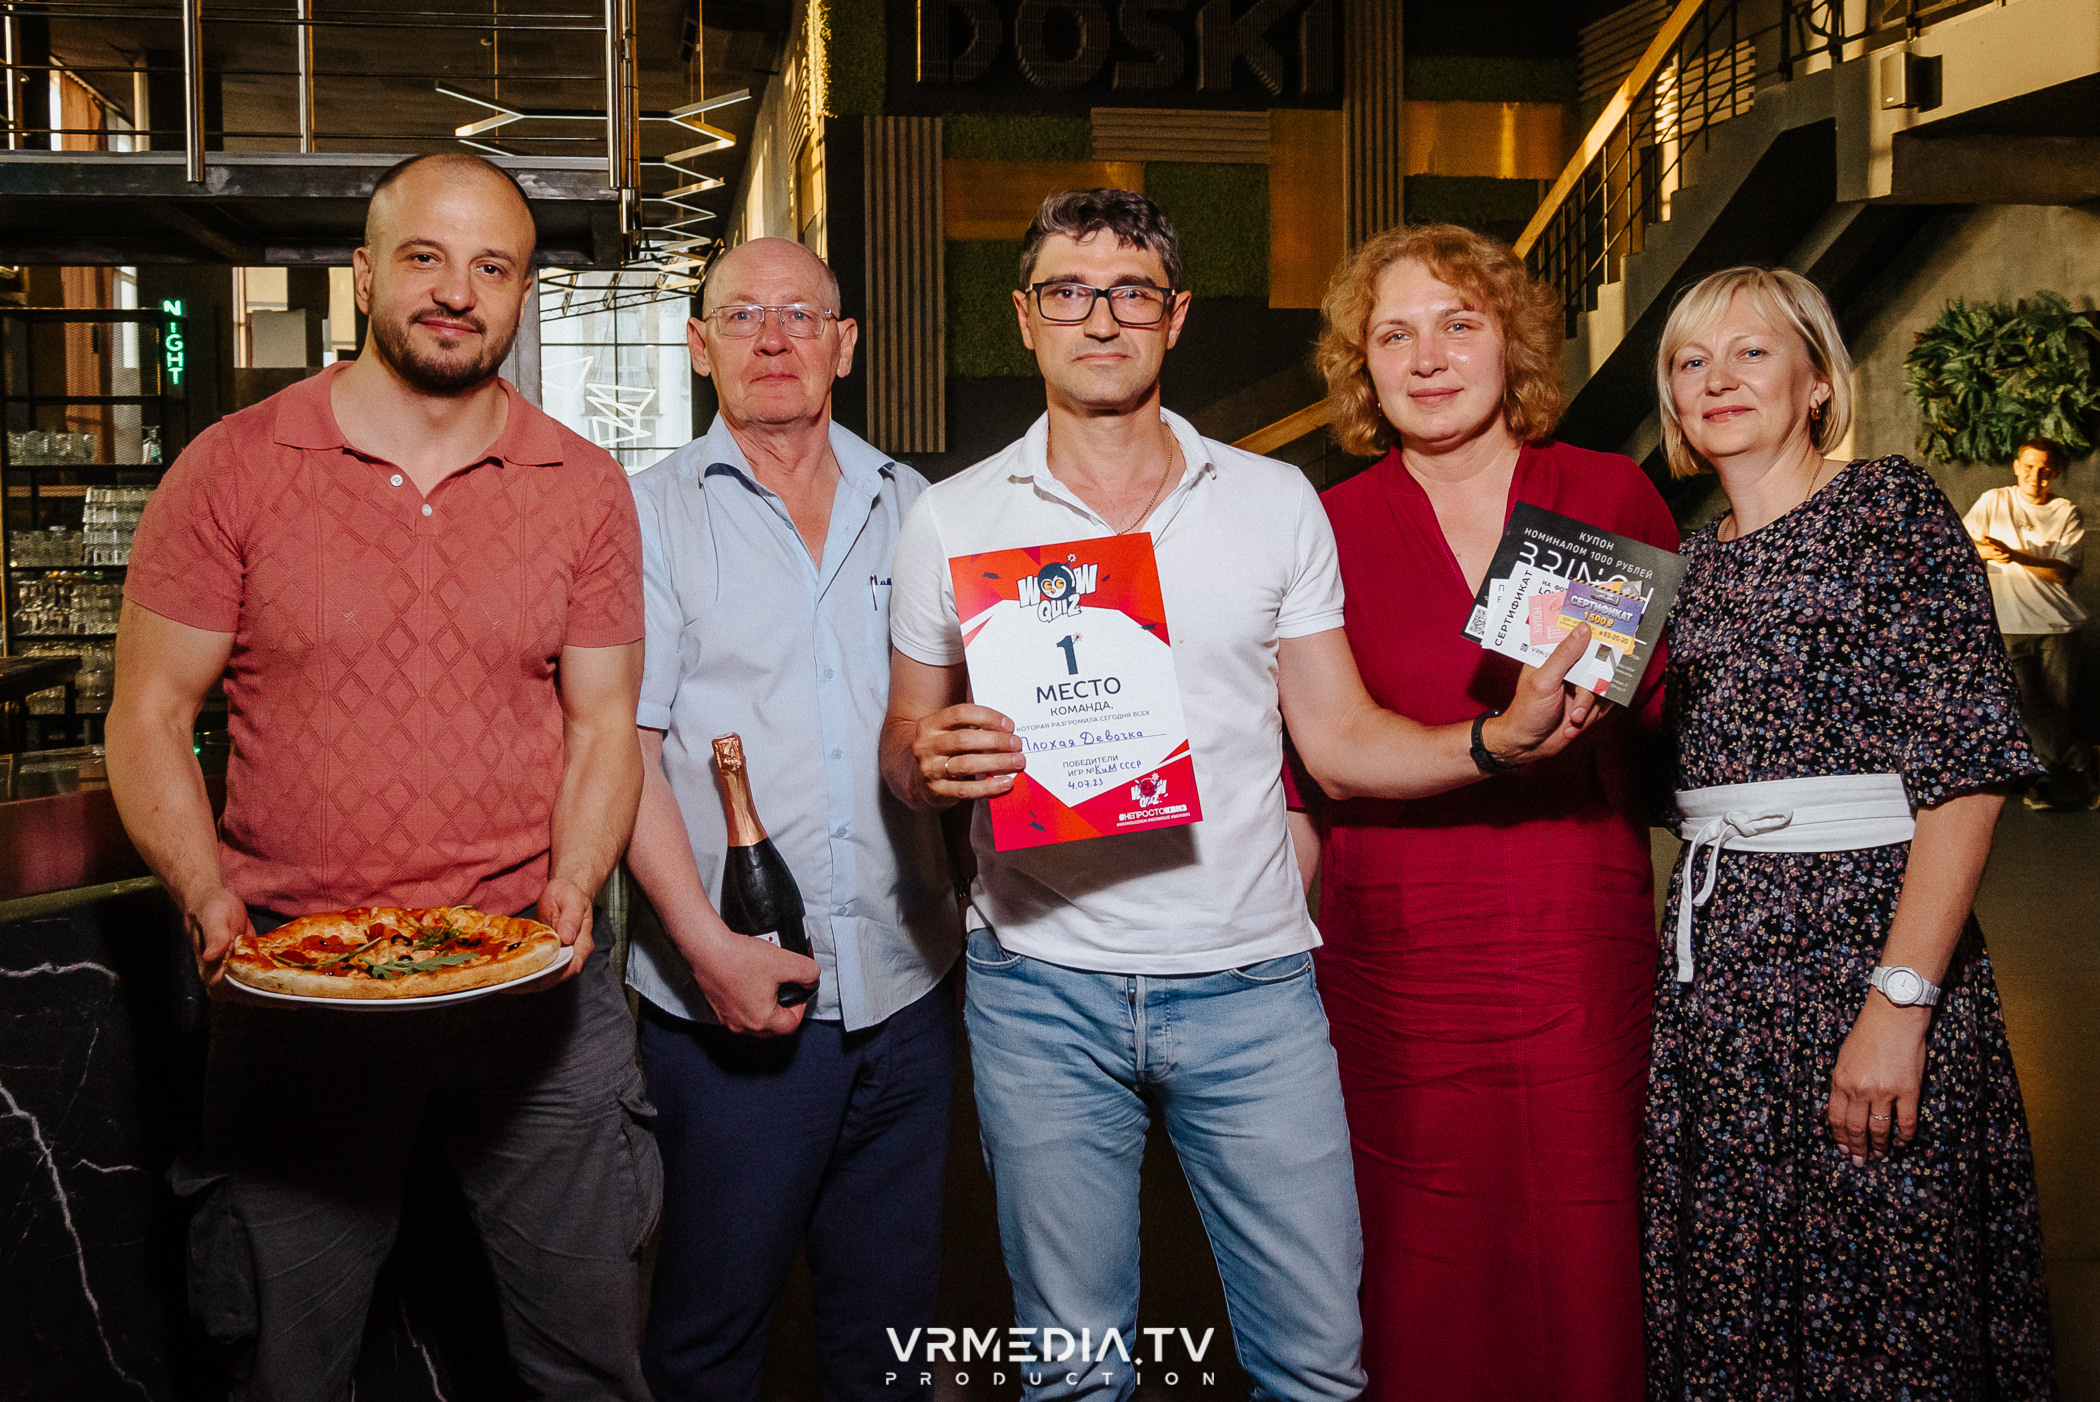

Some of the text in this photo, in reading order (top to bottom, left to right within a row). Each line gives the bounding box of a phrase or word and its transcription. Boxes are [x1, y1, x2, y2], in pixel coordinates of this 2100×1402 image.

[917, 0, 1334, 95] DOSKI
[163, 299, 184, 385] NIGHT
[1578, 531, 1615, 551] КУПОН
[1524, 527, 1655, 580] НОМИНАЛОМ 1000 РУБЛЕЙ
[1541, 580, 1551, 588] НА
[1037, 593, 1082, 623] QUIZ
[1494, 570, 1533, 647] СЕРТИФИКАТ
[1570, 595, 1634, 622] СЕРТИФИКАТ
[1056, 634, 1079, 676] 1
[1036, 677, 1122, 704] МЕСТО
[1050, 701, 1114, 717] КОМАНДА,
[1016, 710, 1150, 732] КОТОРАЯ РАЗГРОМИЛА СЕГОДНЯ ВСЕХ
[1020, 729, 1144, 752] Плохая Девочка
[1062, 754, 1119, 768] ПОБЕДИТЕЛИ
[1067, 768, 1084, 777] ИГР
[1119, 759, 1142, 770] СССР
[1068, 778, 1104, 789] 4.07.23
[1118, 803, 1188, 821] #НЕПРОСТОКВИЗ
